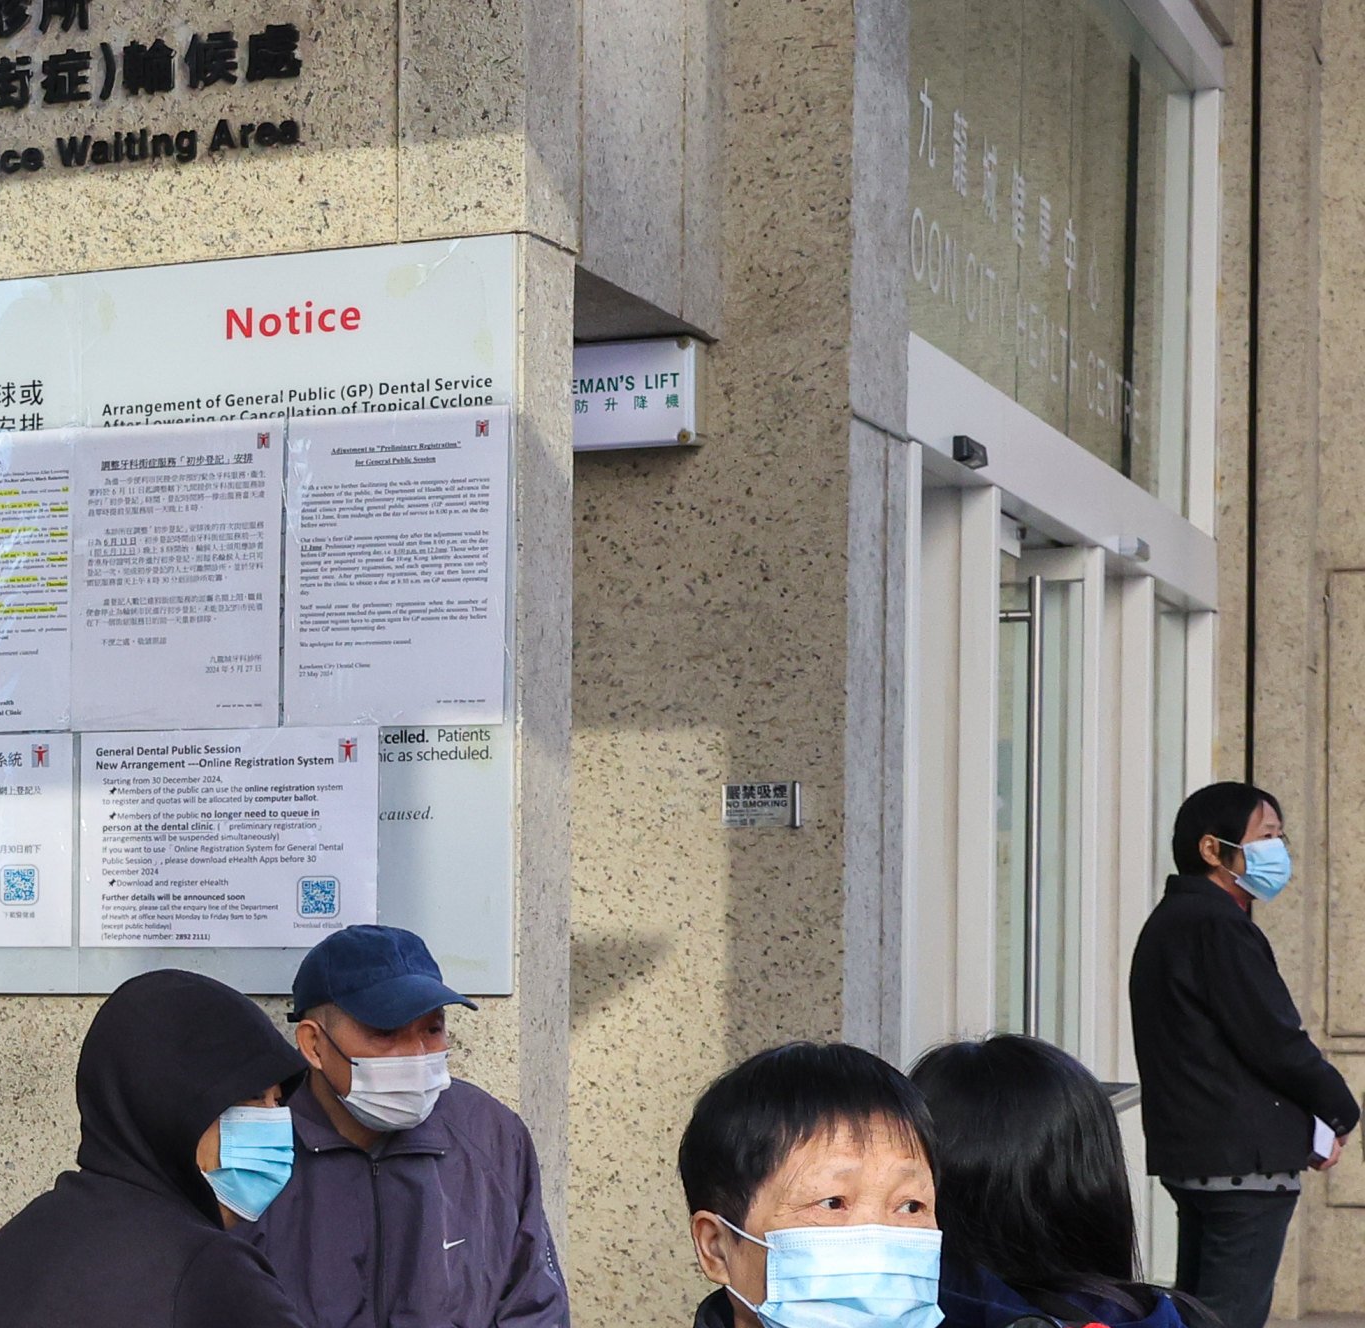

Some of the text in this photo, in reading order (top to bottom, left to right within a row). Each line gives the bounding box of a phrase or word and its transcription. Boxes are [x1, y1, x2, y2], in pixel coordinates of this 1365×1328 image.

[56, 124, 199, 170] Waiting
[209, 114, 303, 152] Area
[225, 301, 362, 340] Notice
[645, 373, 680, 390] LIFT
[102, 375, 493, 417] Arrangement of General Public (GP) Dental Service
[379, 728, 491, 745] celled. Patients
[95, 744, 241, 757] General Dental Public Session
[398, 751, 413, 762] as
[417, 745, 493, 762] scheduled.
[96, 760, 118, 770] New
[120, 760, 185, 770] Arrangement
[234, 756, 295, 769] Registration
[297, 756, 334, 768] System
[742, 800, 788, 808] SMOKING
[379, 805, 434, 821] caused.
